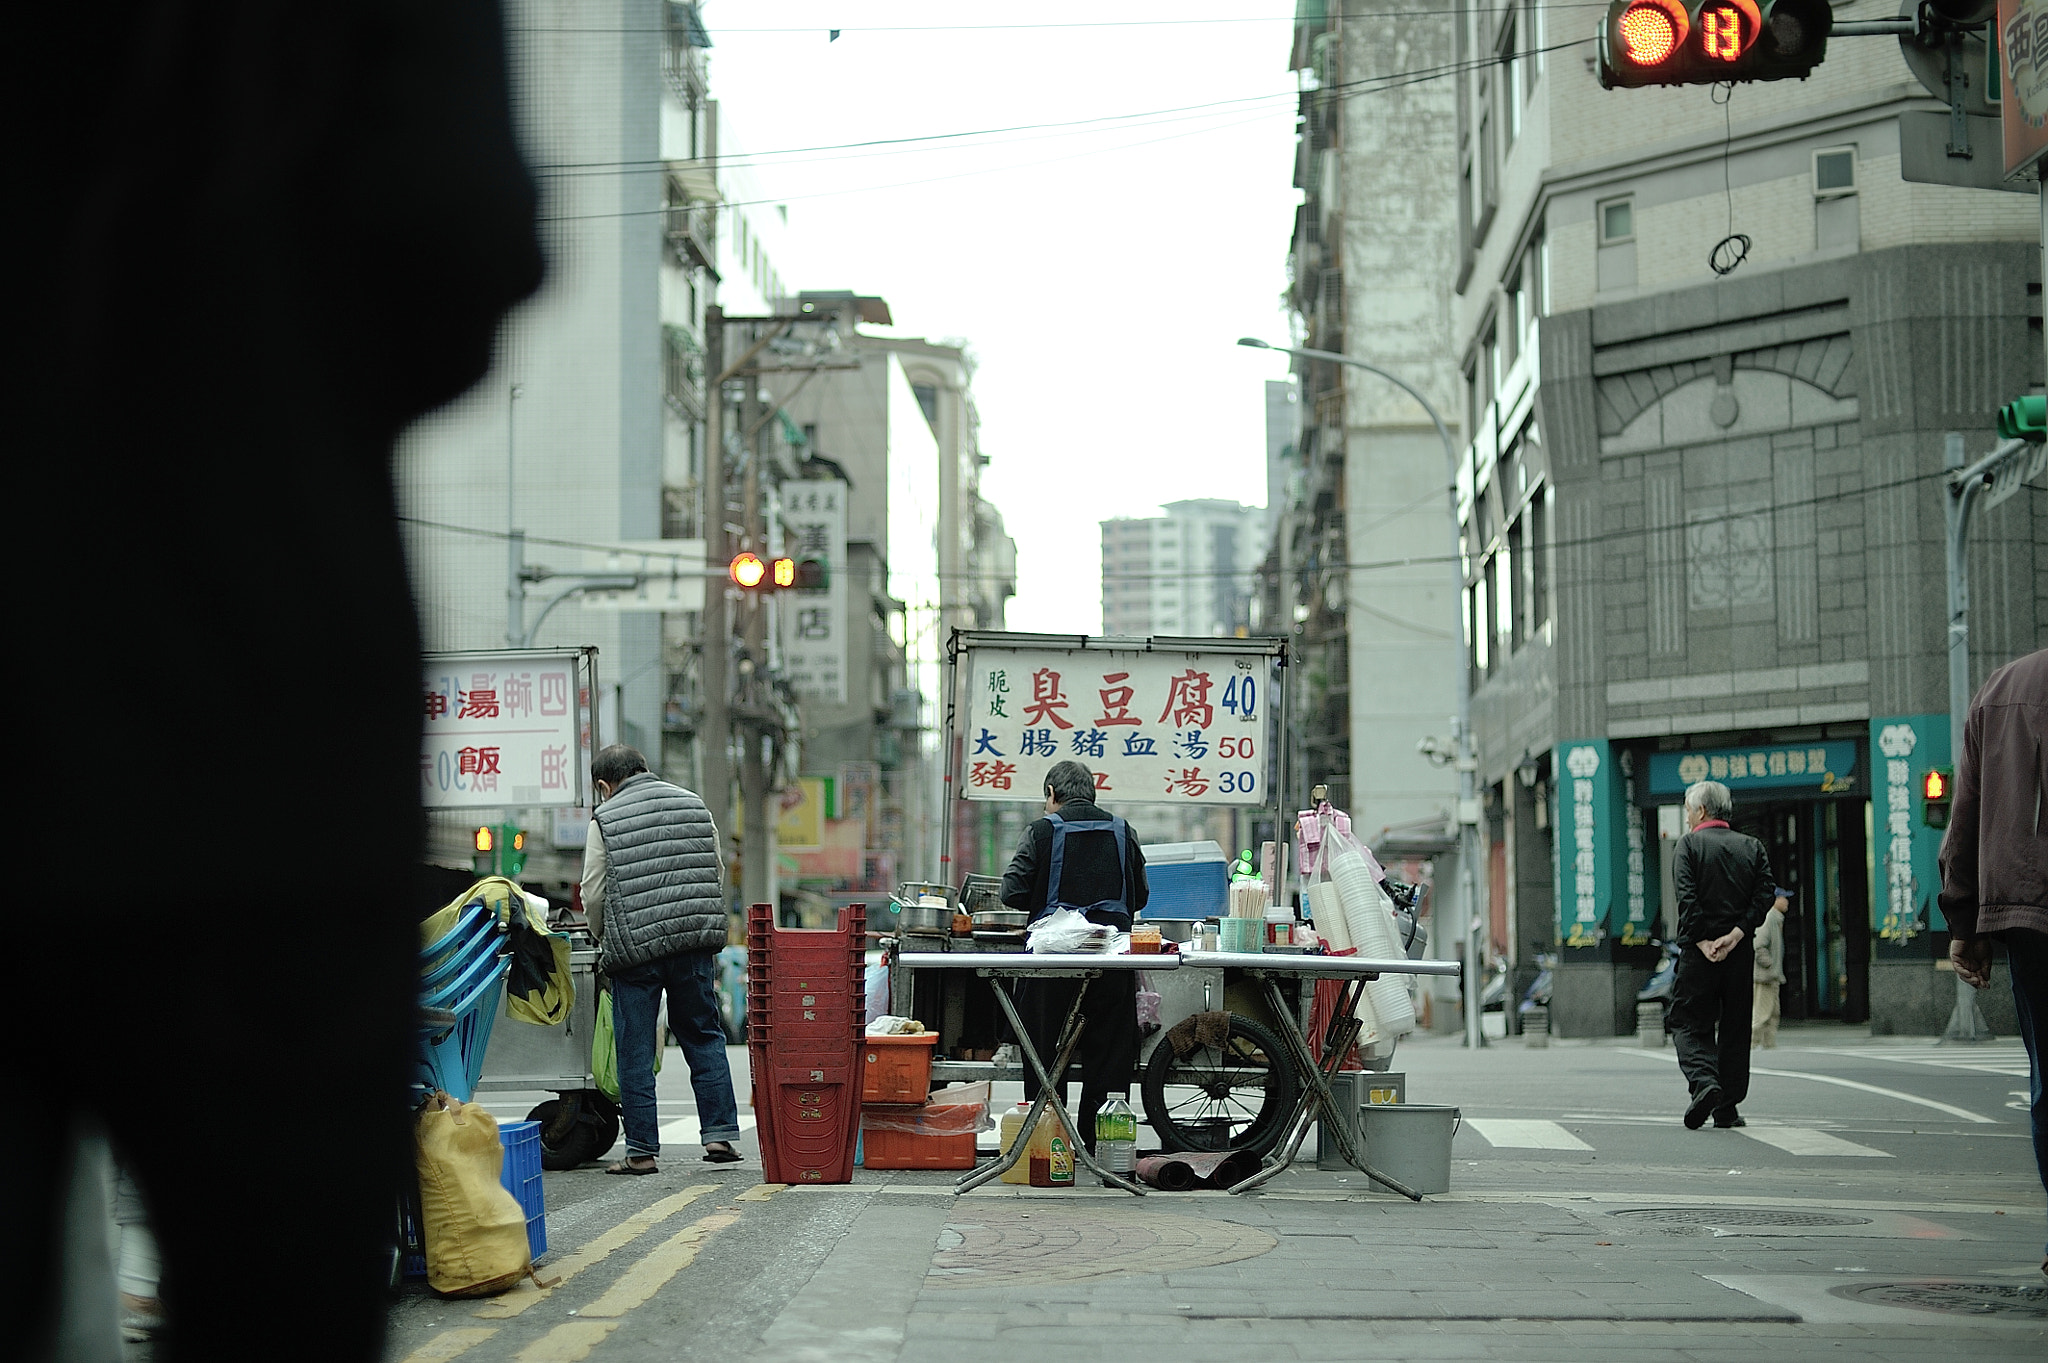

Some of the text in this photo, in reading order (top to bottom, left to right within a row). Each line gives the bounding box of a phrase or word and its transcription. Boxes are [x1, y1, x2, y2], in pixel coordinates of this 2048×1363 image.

[1703, 8, 1740, 61] 13
[988, 670, 1011, 719] 脆皮
[1023, 667, 1256, 730] 臭豆腐 40
[458, 746, 501, 775] 飯
[972, 728, 1255, 760] 大腸豬血湯 50
[1218, 771, 1256, 794] 30
